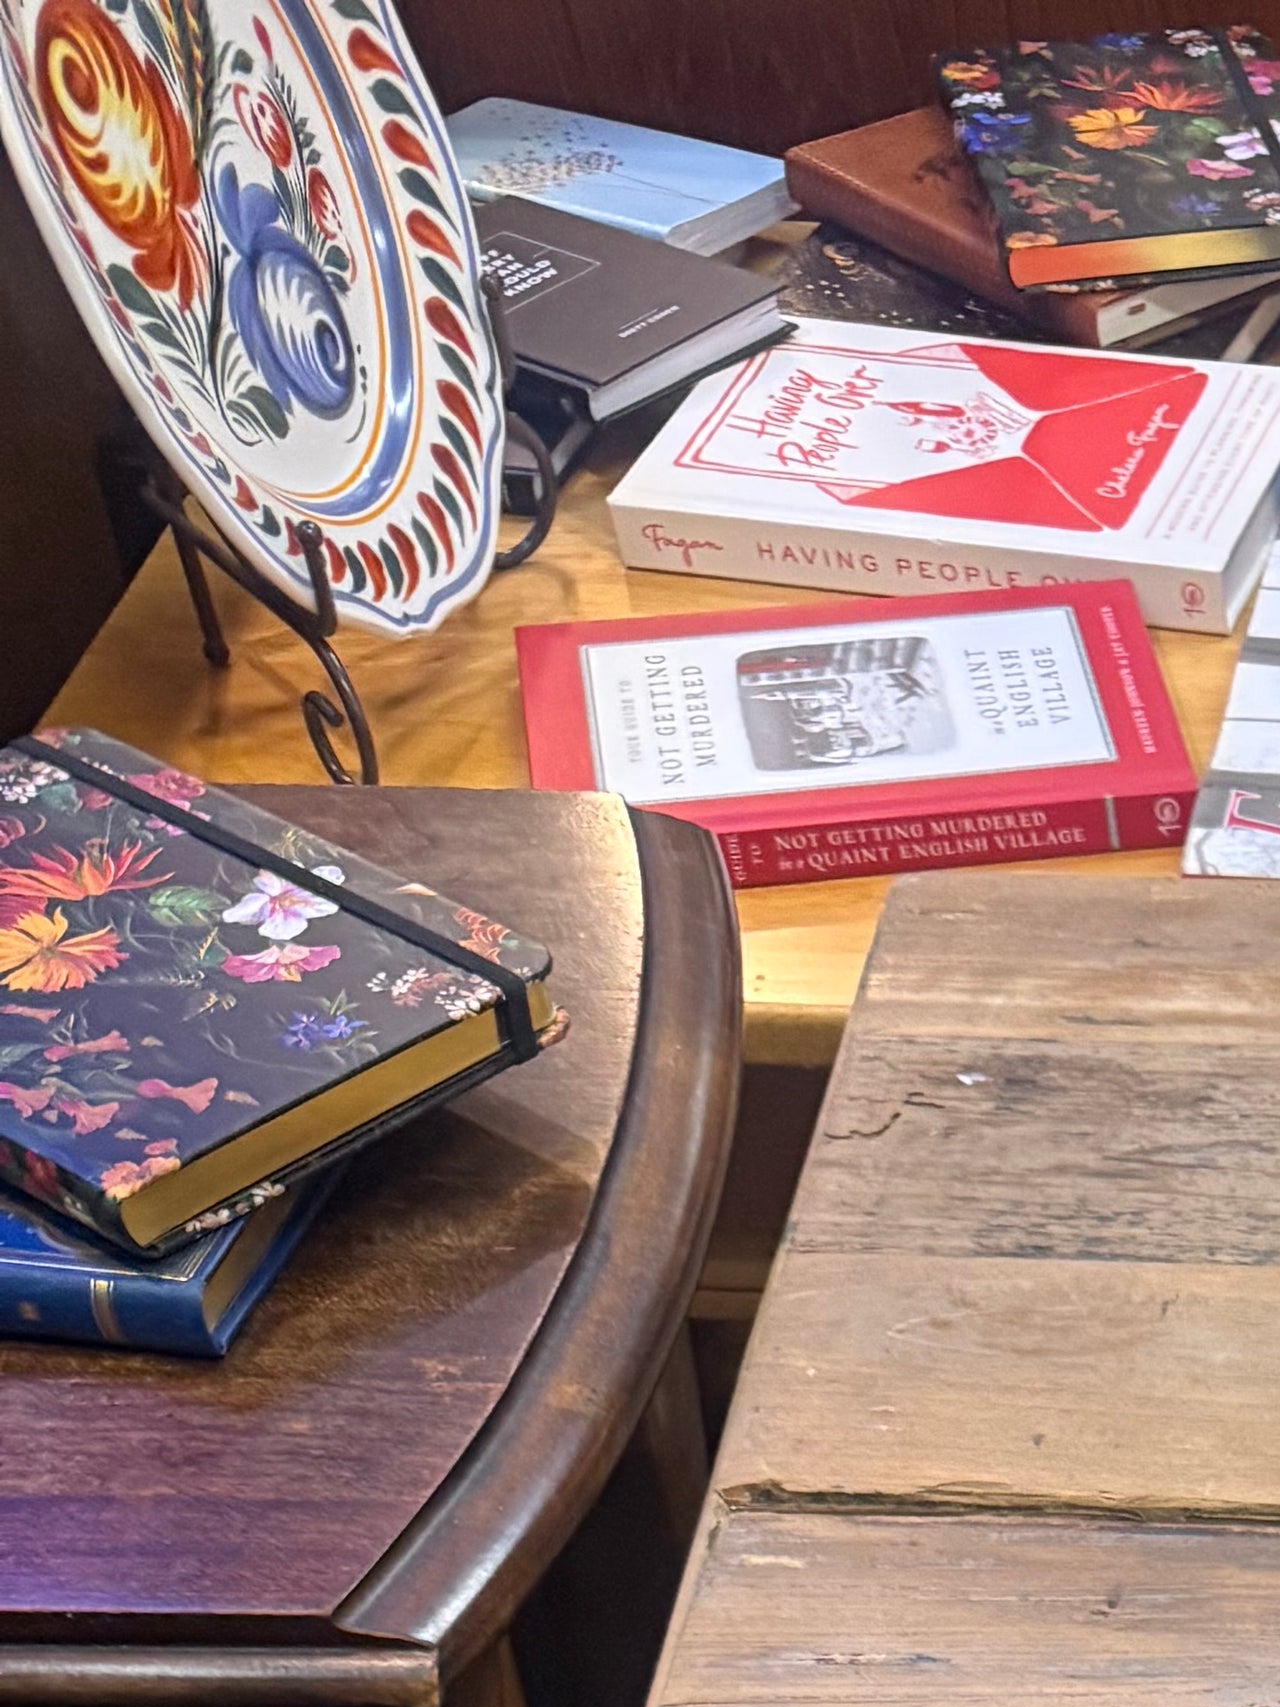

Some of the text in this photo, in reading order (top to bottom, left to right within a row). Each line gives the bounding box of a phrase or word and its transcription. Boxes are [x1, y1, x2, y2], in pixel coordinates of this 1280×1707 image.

[503, 259, 552, 287] OULD
[503, 268, 559, 297] KNOW
[726, 368, 843, 438] Having
[764, 364, 885, 471] People Over
[1095, 446, 1145, 499] Chelsea
[641, 522, 1022, 588] Fagan HAVING PEOPLE
[680, 665, 719, 768] MURDERED
[964, 648, 1009, 719] QUAINT
[997, 649, 1040, 728] ENGLISH
[1030, 646, 1072, 726] VILLAGE
[644, 654, 686, 786] NOT GETTING
[774, 809, 1048, 851] NOT GETTING MURDERED
[806, 846, 892, 873] QUAINT
[900, 834, 989, 861] ENGLISH
[993, 827, 1088, 851] VILLAGE
